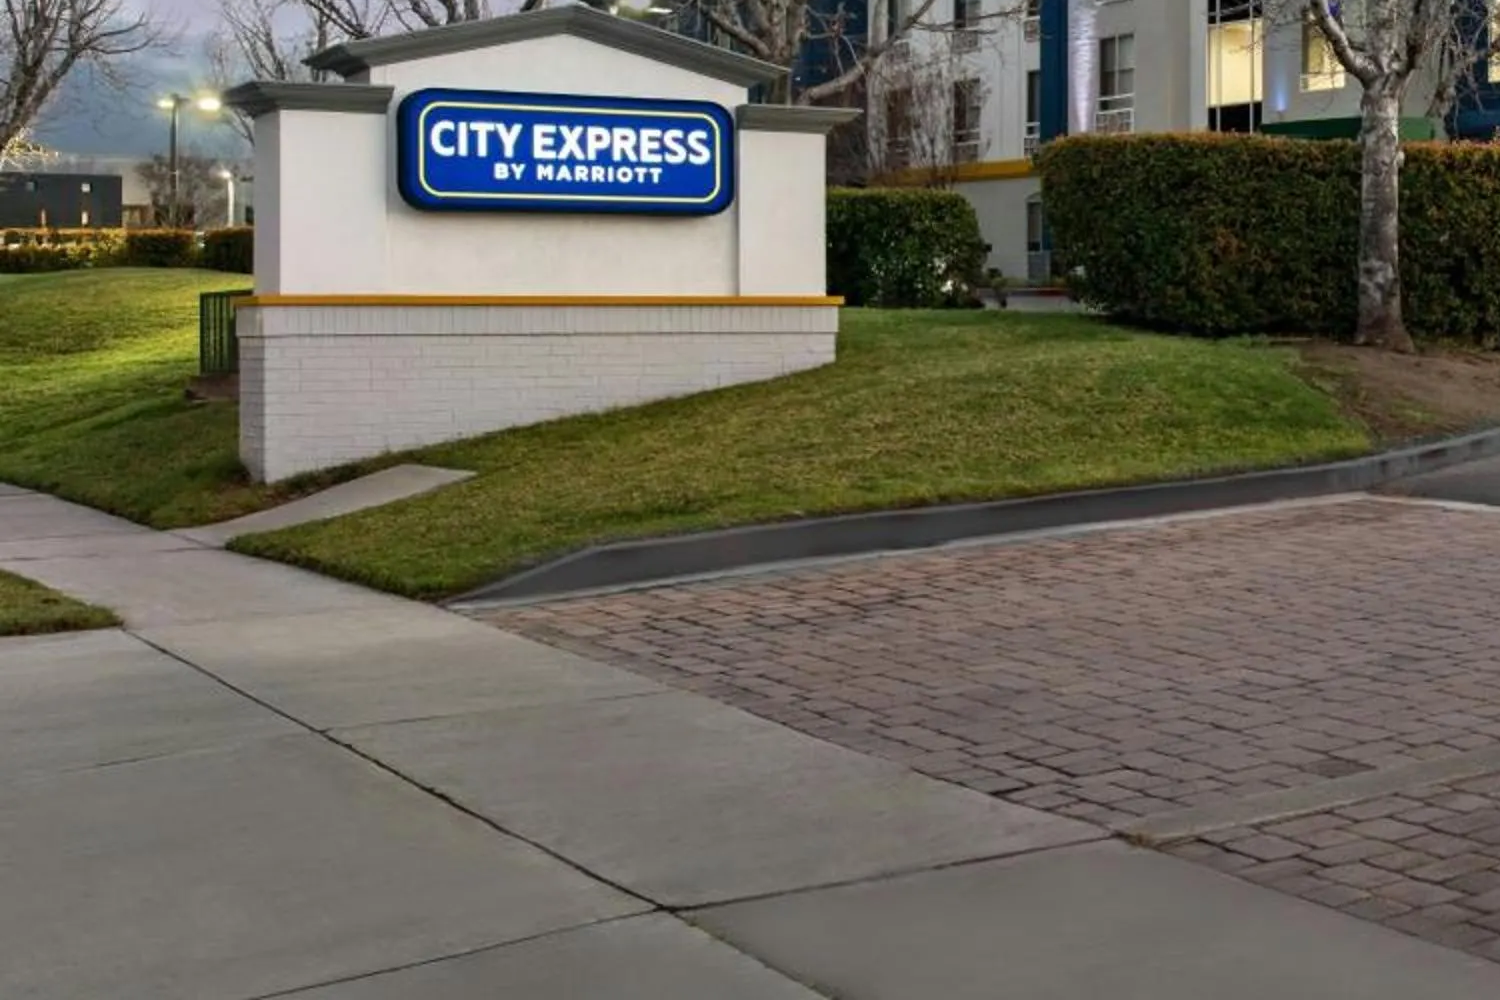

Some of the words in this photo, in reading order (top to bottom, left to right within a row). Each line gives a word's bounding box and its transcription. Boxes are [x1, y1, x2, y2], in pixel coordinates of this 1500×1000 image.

[430, 120, 522, 158] CITY
[533, 124, 711, 165] EXPRESS
[494, 163, 526, 180] BY
[536, 164, 662, 184] MARRIOTT
